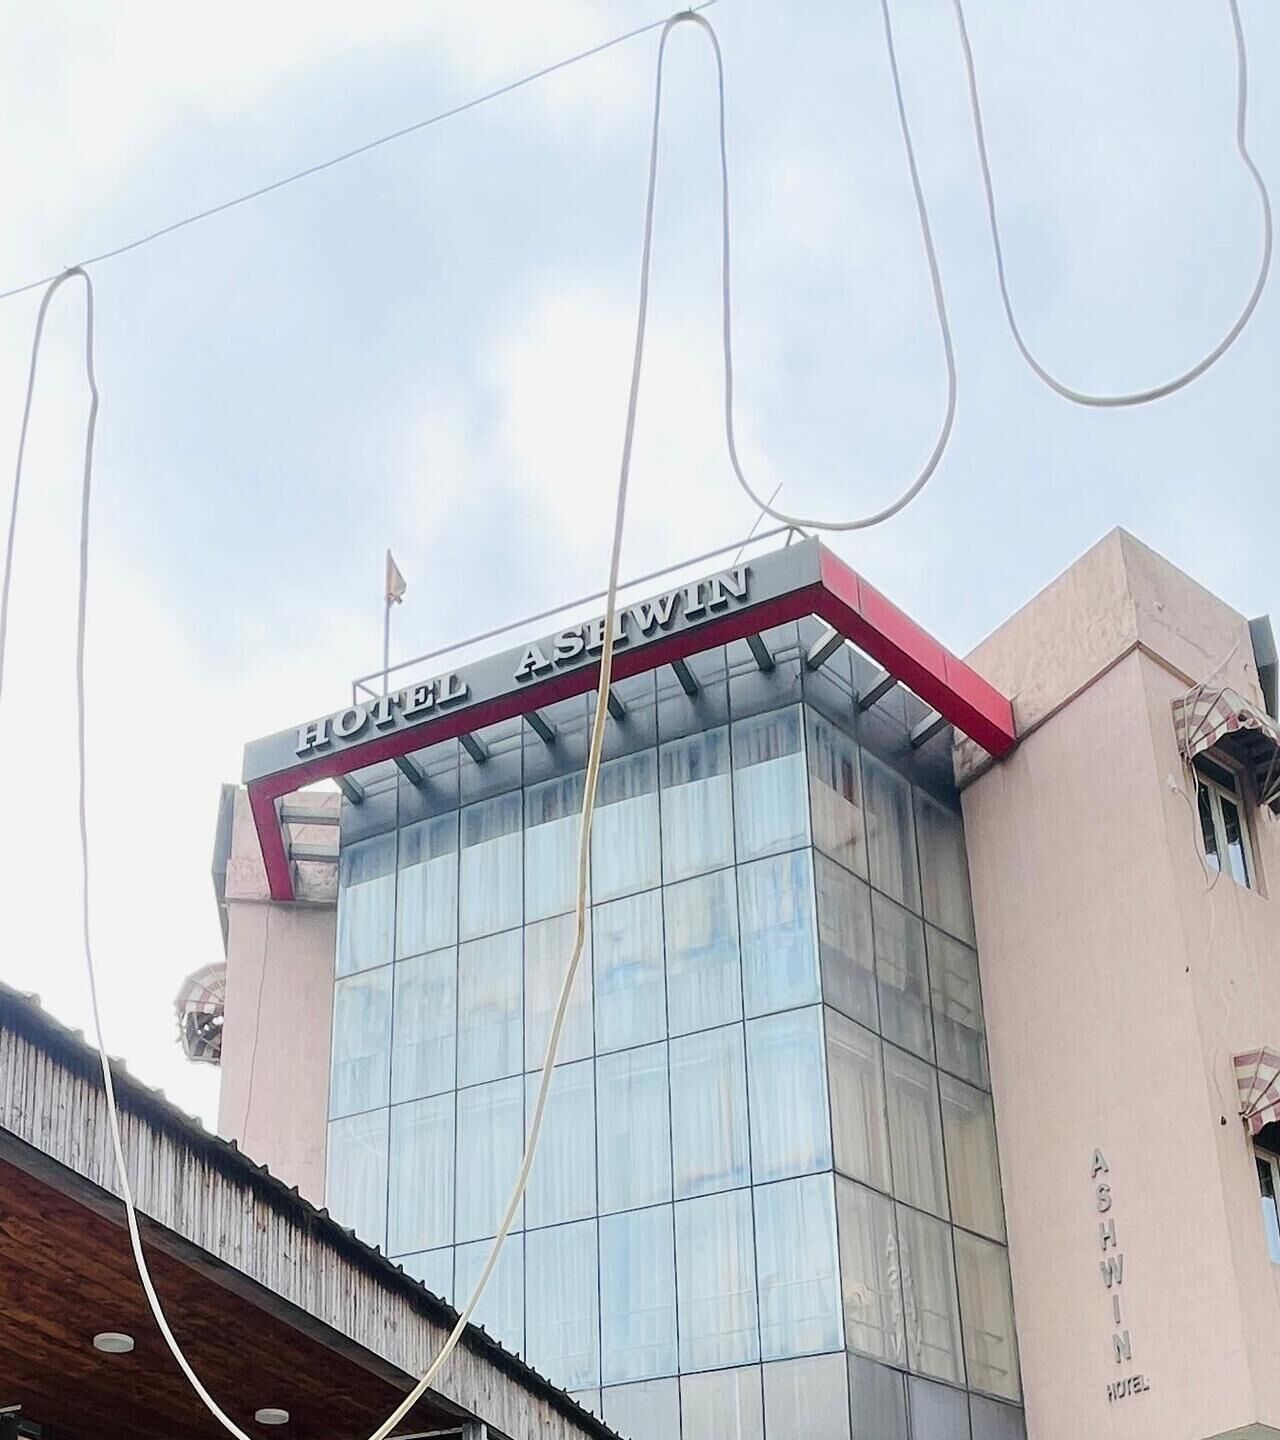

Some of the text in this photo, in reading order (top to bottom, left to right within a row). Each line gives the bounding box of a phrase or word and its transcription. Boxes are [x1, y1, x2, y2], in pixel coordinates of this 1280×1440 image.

[296, 566, 753, 758] HOTEL ASHWIN
[1091, 1148, 1132, 1364] ASHWIN
[1106, 1374, 1151, 1402] HOTEL
